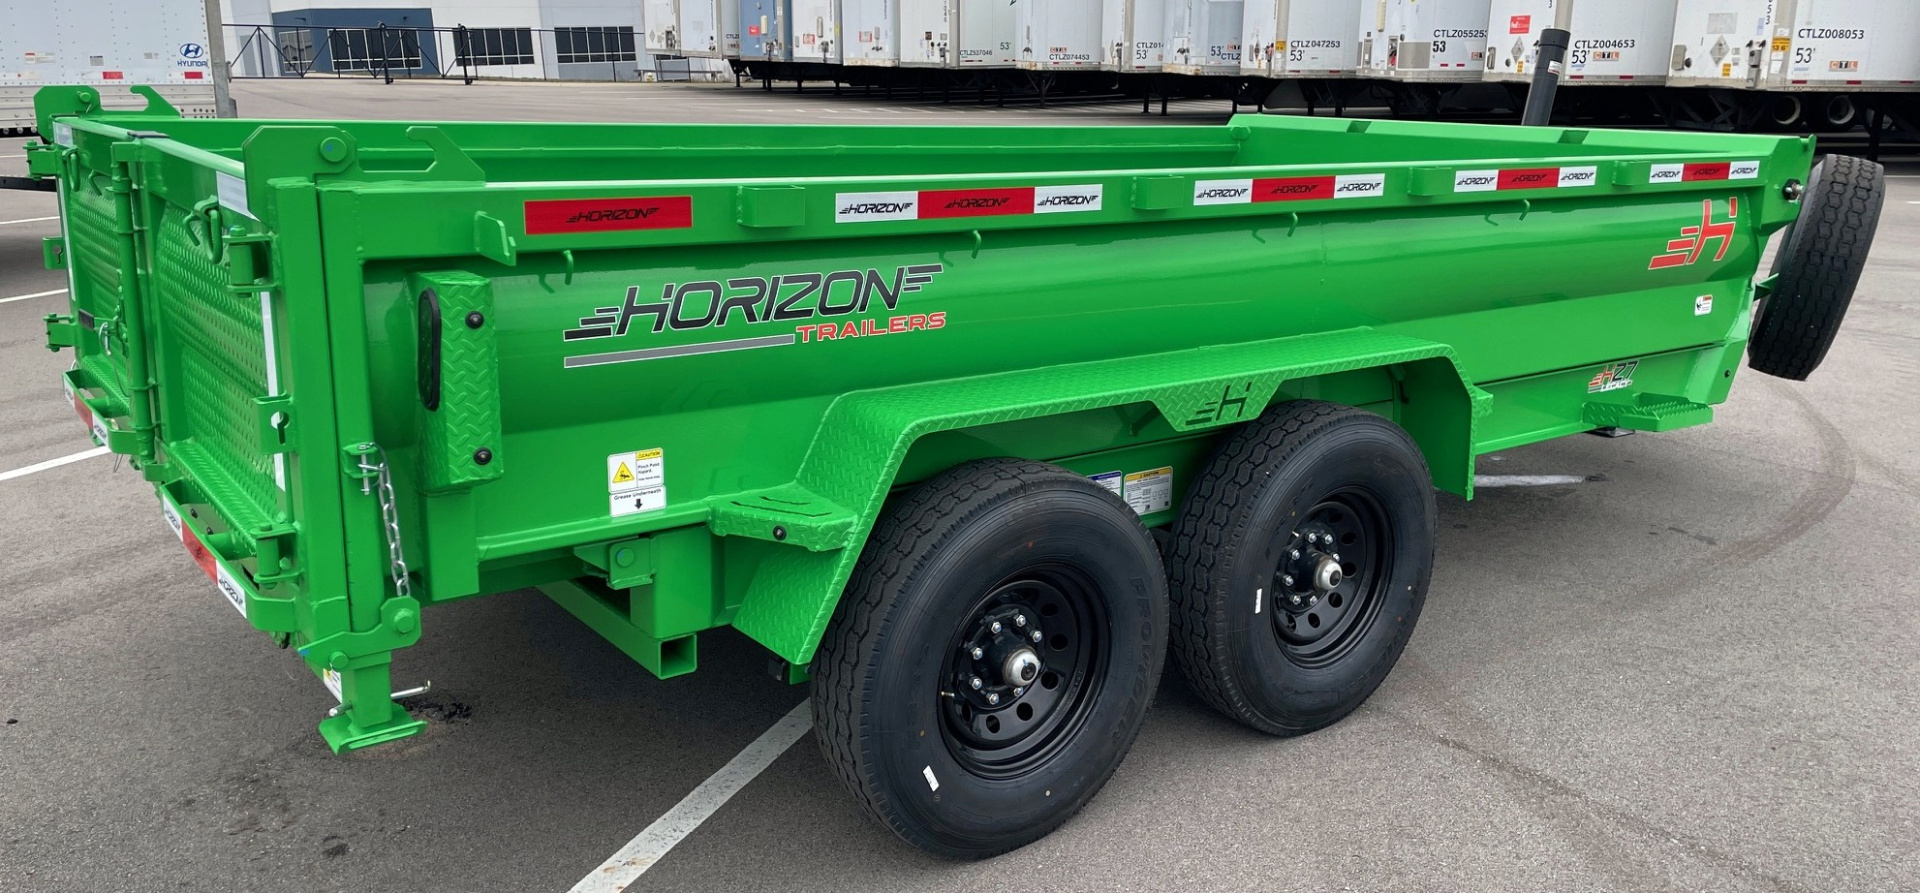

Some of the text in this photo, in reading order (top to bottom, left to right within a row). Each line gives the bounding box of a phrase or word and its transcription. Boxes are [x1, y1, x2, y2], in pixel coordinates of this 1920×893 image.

[1798, 28, 1865, 39] CTLZ008053
[1290, 40, 1341, 48] CTLZ047253
[1432, 40, 1446, 52] 53
[1574, 39, 1635, 49] CTLZ004653
[1290, 50, 1305, 61] 53'
[1571, 50, 1590, 64] 53'
[1795, 47, 1816, 64] 53'
[1202, 188, 1243, 198] HORIZON
[1342, 182, 1377, 192] HORIZON
[846, 194, 1092, 215] HORIZON HORIZON HORIZON
[576, 208, 650, 222] HORIZON
[613, 266, 906, 336] HORIZON
[796, 311, 947, 343] TRAILERS
